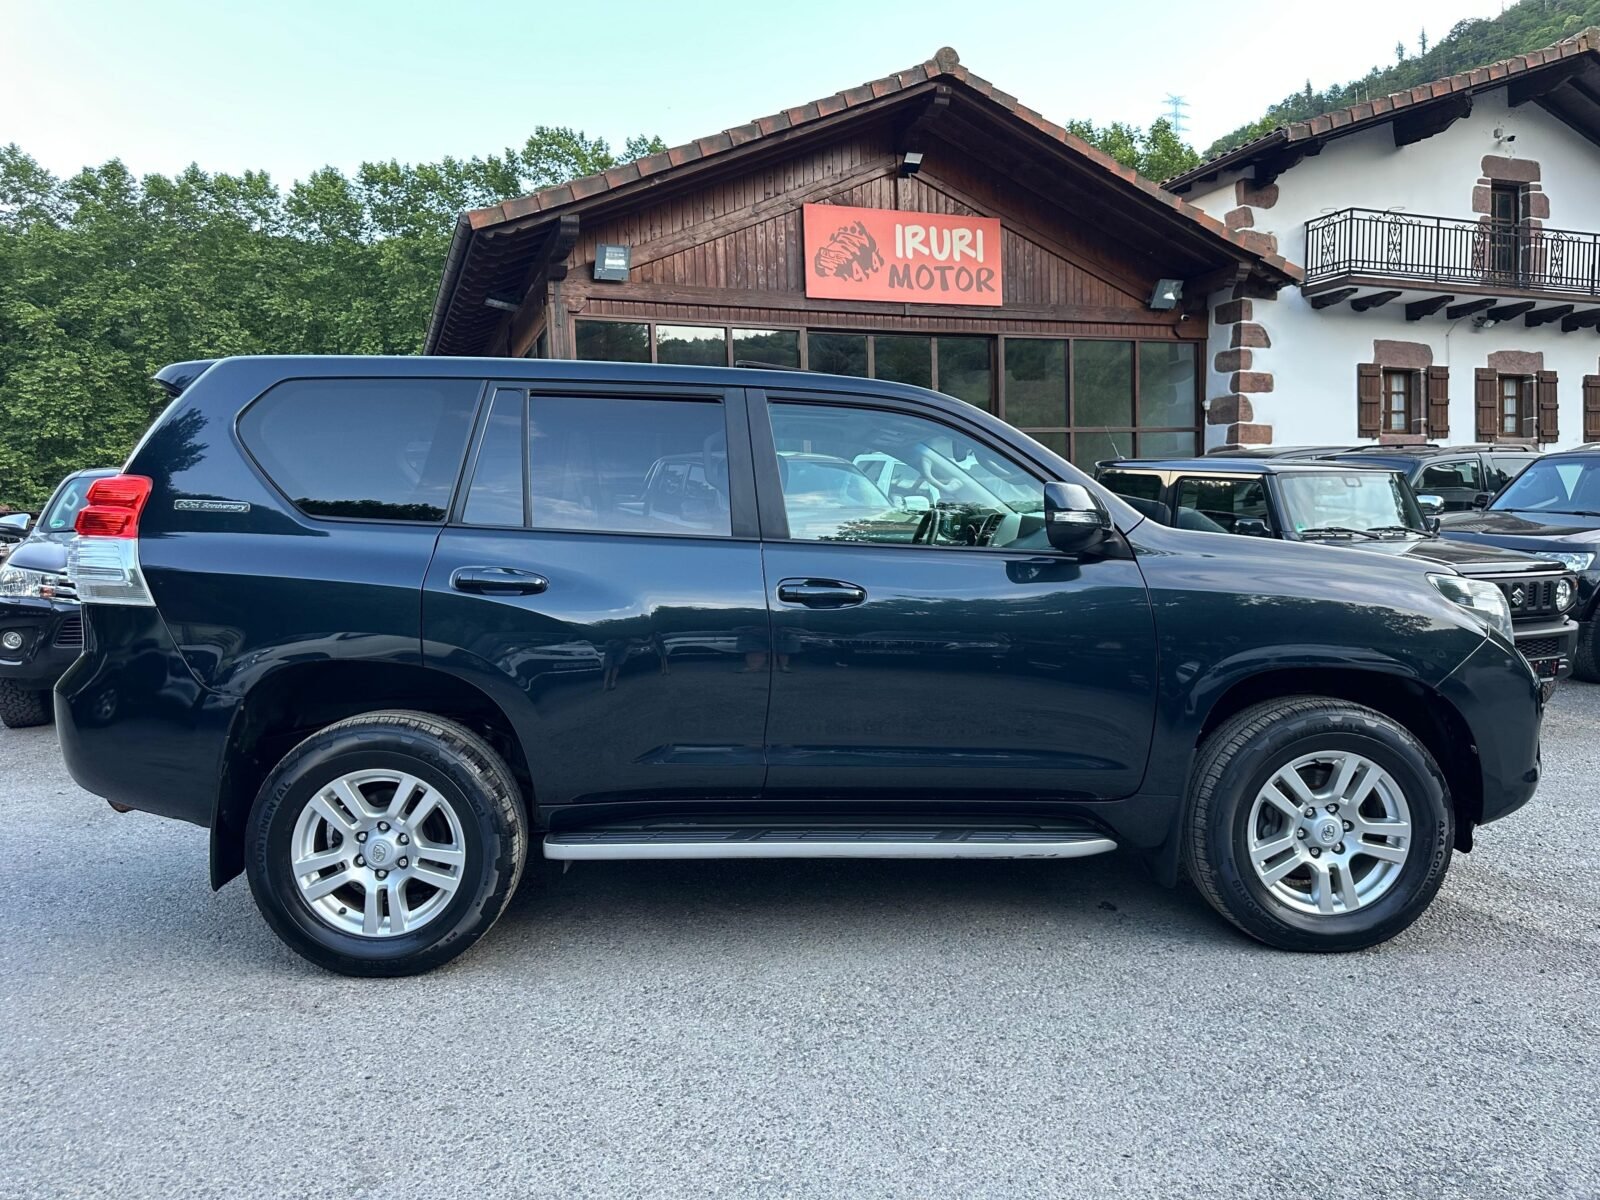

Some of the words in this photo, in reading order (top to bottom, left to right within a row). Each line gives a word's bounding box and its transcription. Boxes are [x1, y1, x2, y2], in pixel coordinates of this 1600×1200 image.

[895, 223, 984, 263] IRURI
[888, 263, 995, 293] MOTOR
[200, 502, 247, 512] Anniversary
[255, 781, 292, 875] CONTINENTAL
